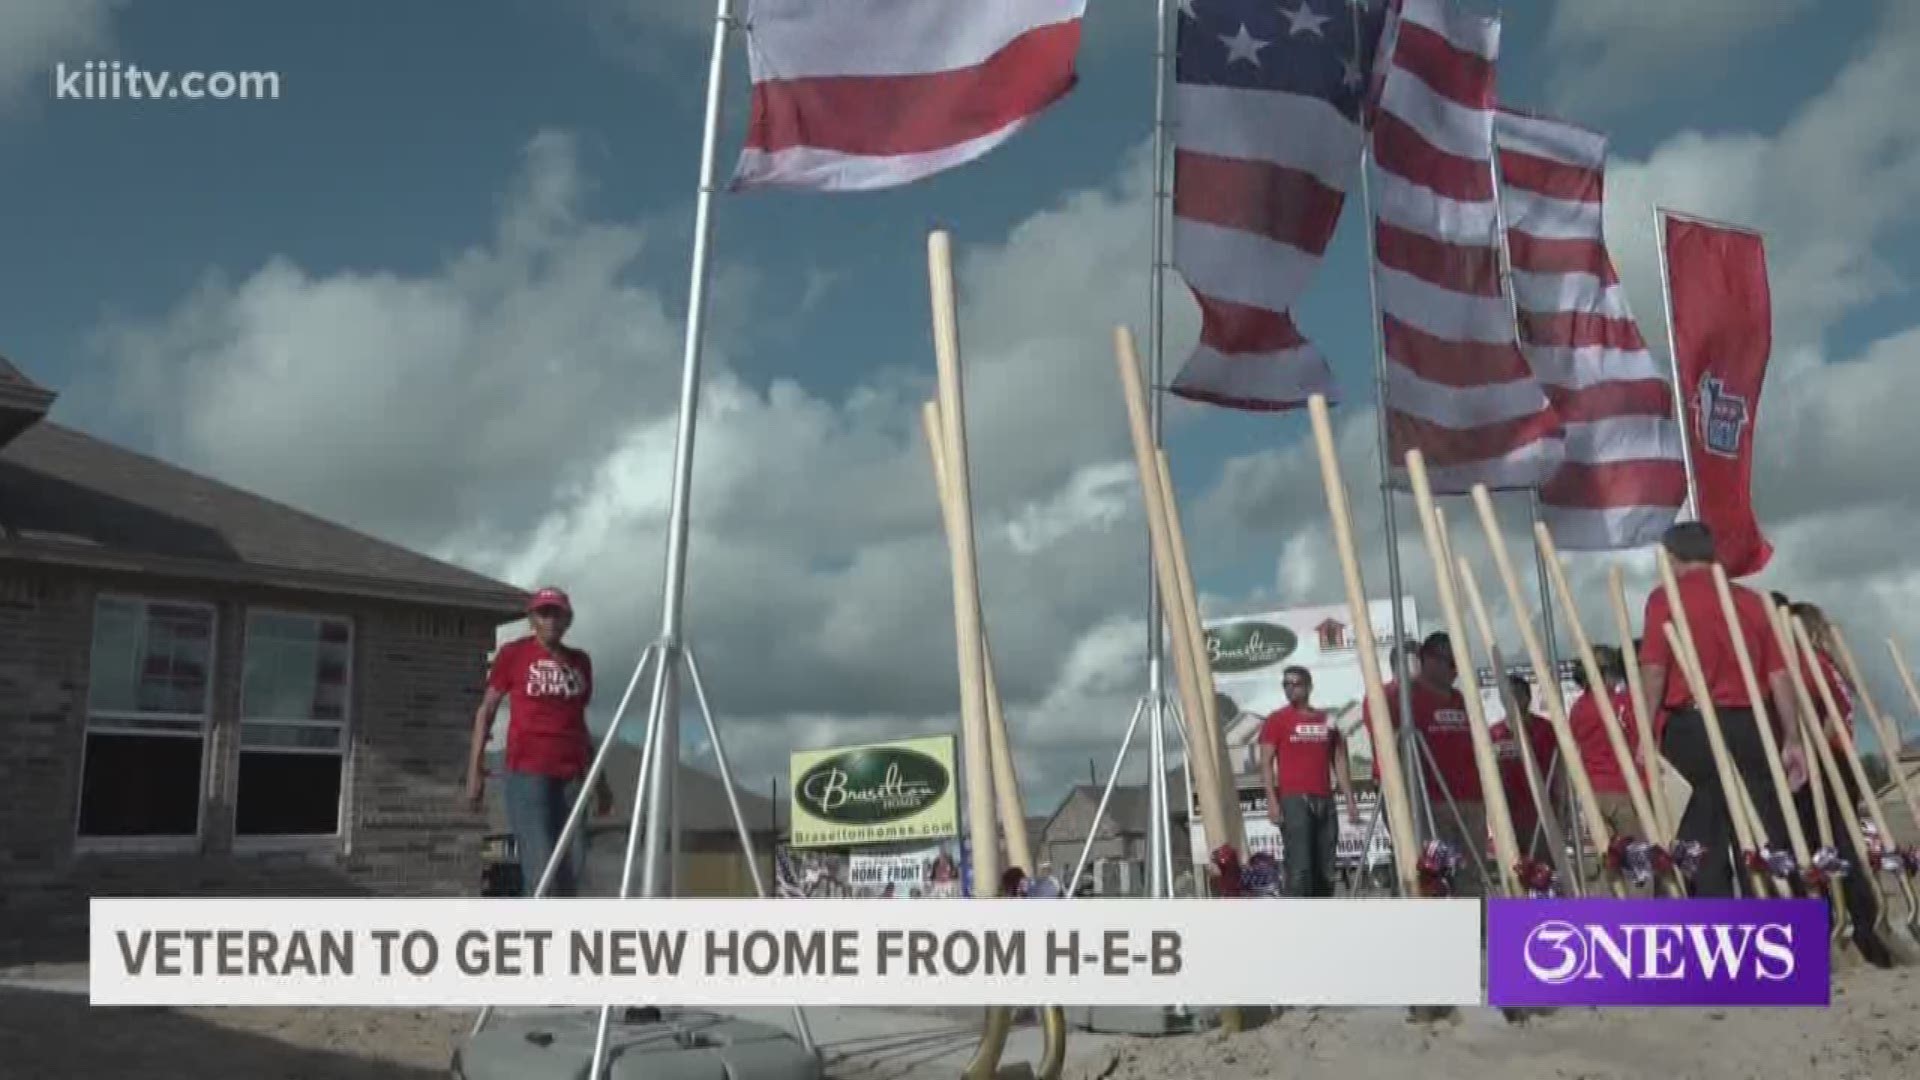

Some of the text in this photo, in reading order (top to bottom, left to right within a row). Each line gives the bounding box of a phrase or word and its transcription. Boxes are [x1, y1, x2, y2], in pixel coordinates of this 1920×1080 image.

[804, 762, 937, 813] Braselton
[851, 866, 920, 880] HOME FRONT
